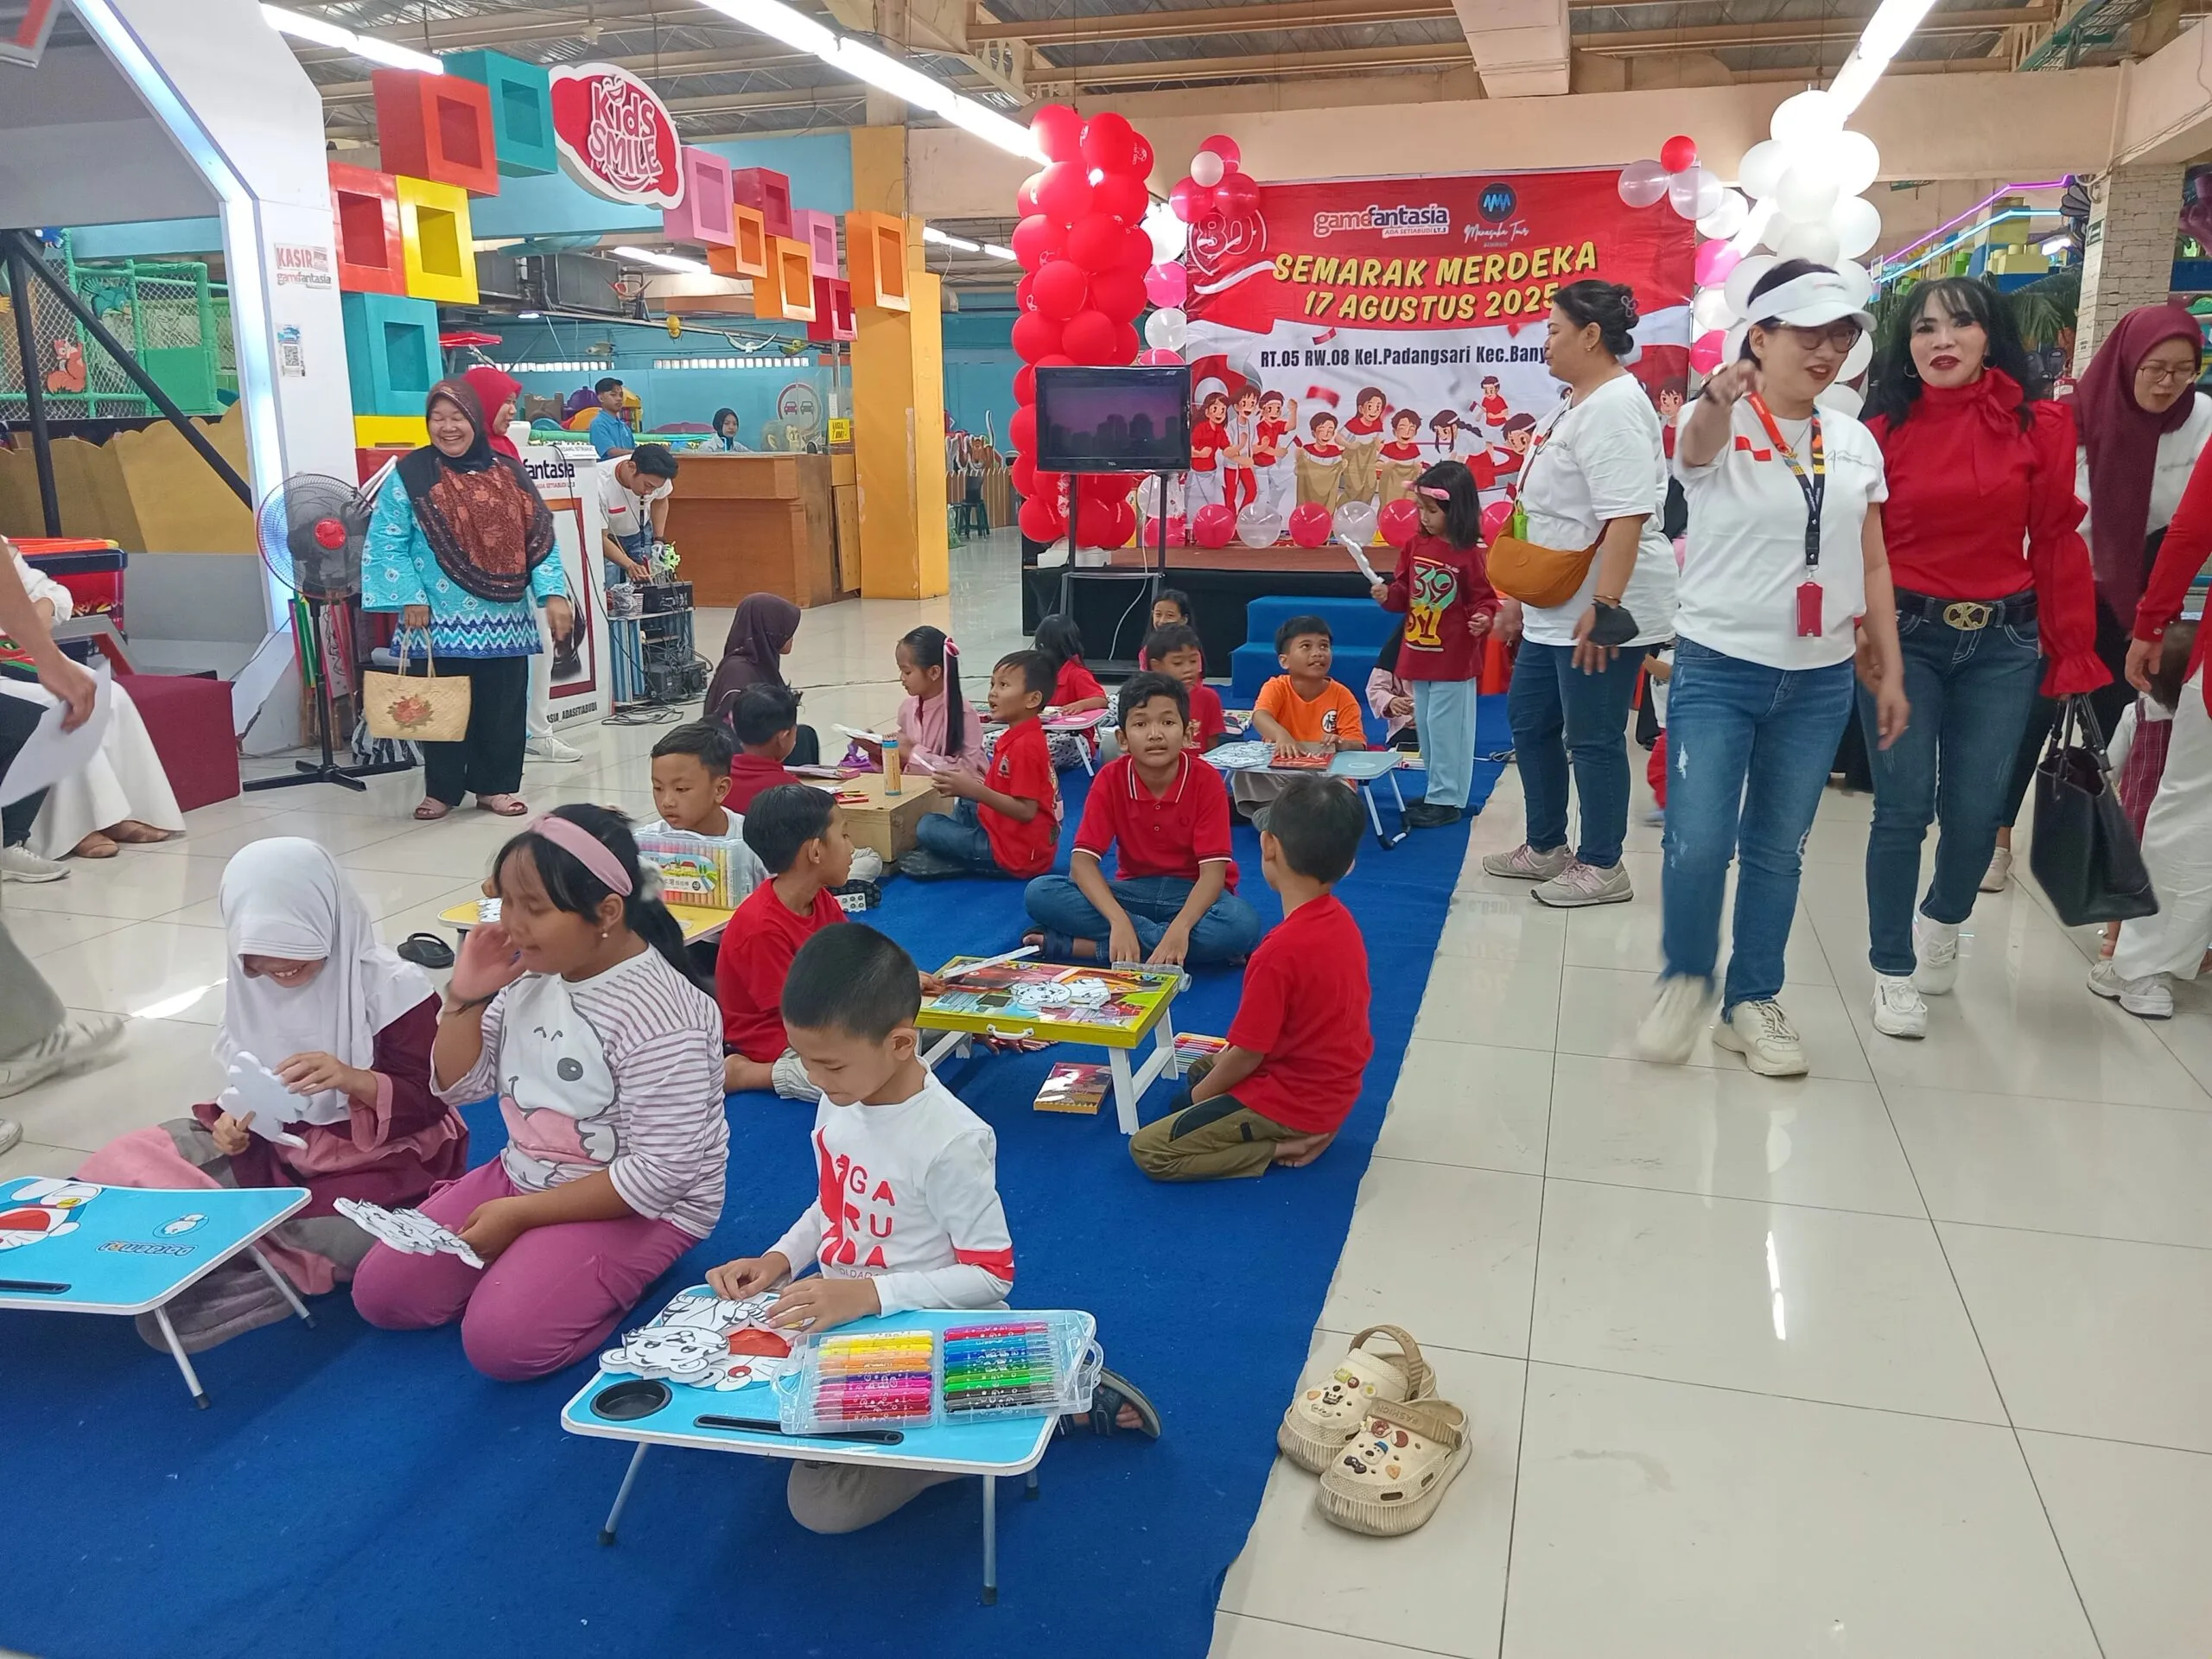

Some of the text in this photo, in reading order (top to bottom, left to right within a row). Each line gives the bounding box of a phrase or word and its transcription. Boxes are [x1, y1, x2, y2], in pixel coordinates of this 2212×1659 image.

[588, 121, 664, 178] SMILE
[276, 247, 314, 269] KASIR
[1272, 241, 1597, 288] SEMARAK MERDEKA
[1304, 282, 1560, 322] 17 AGUSTUS 2025
[1260, 346, 1546, 368] RT.05 RW.08 Kel.Padangsari Kec.Bany
[523, 459, 575, 480] fantasia
